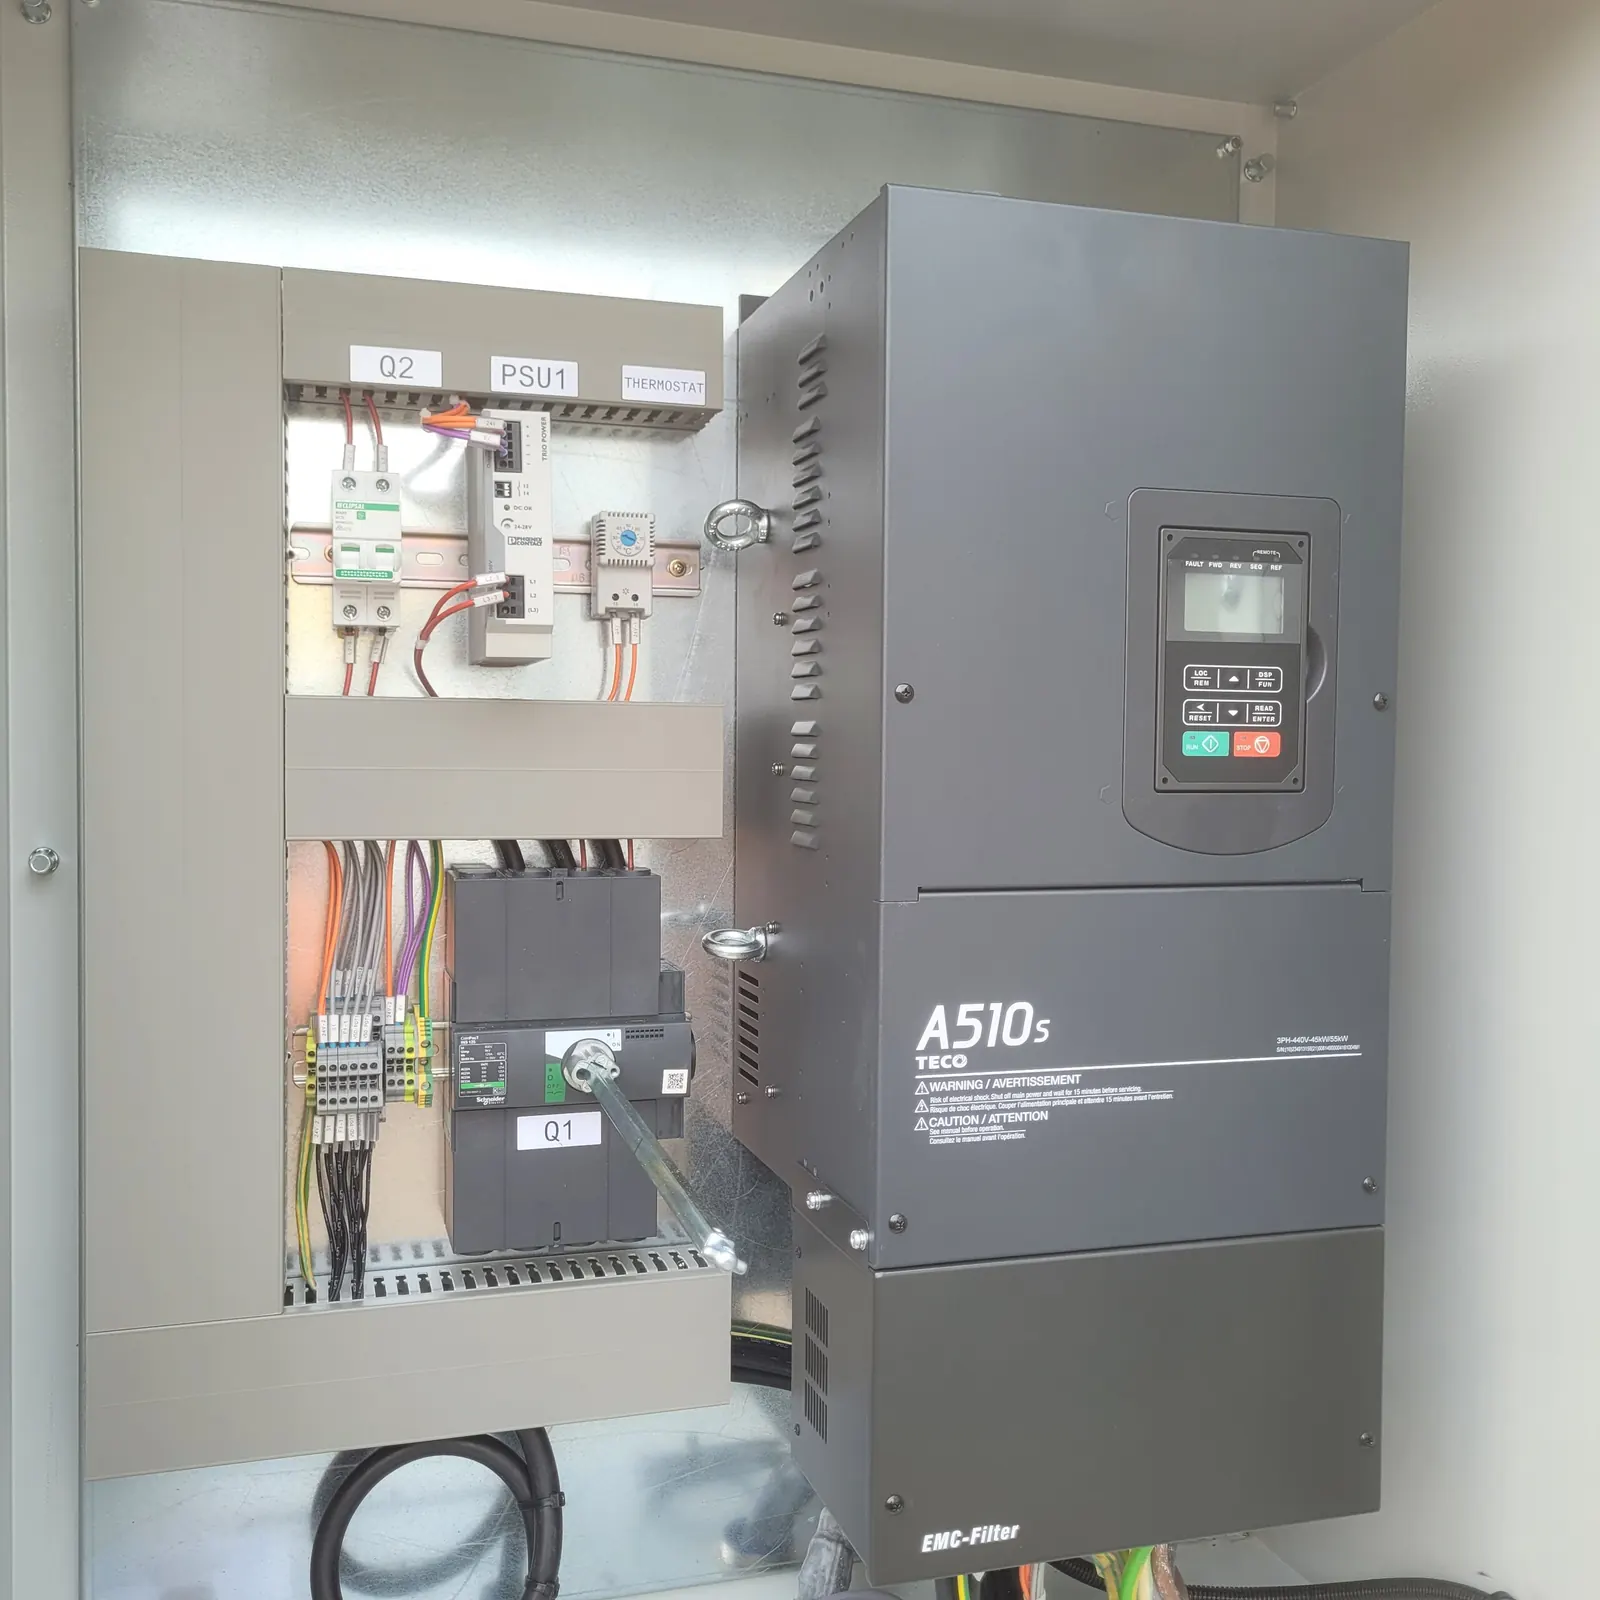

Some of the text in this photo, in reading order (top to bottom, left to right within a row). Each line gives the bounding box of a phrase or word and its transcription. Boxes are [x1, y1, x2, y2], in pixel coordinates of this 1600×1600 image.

[379, 354, 414, 379] Q2
[501, 363, 567, 390] PSU1
[624, 377, 705, 394] THERMOSTAT
[1185, 560, 1204, 568] FAULT
[915, 1054, 968, 1070] TECO
[929, 1074, 1082, 1092] WARNING / AVERTISSEMENT
[930, 1096, 942, 1104] Risk
[1081, 1087, 1101, 1095] minutes
[930, 1105, 948, 1114] Risque
[998, 1102, 1016, 1110] Couper
[1052, 1098, 1077, 1107] principale
[928, 1110, 1049, 1128] CAUTION / ATTENTION
[544, 1119, 572, 1142] Q1
[921, 1524, 1020, 1553] EMC-Filter
